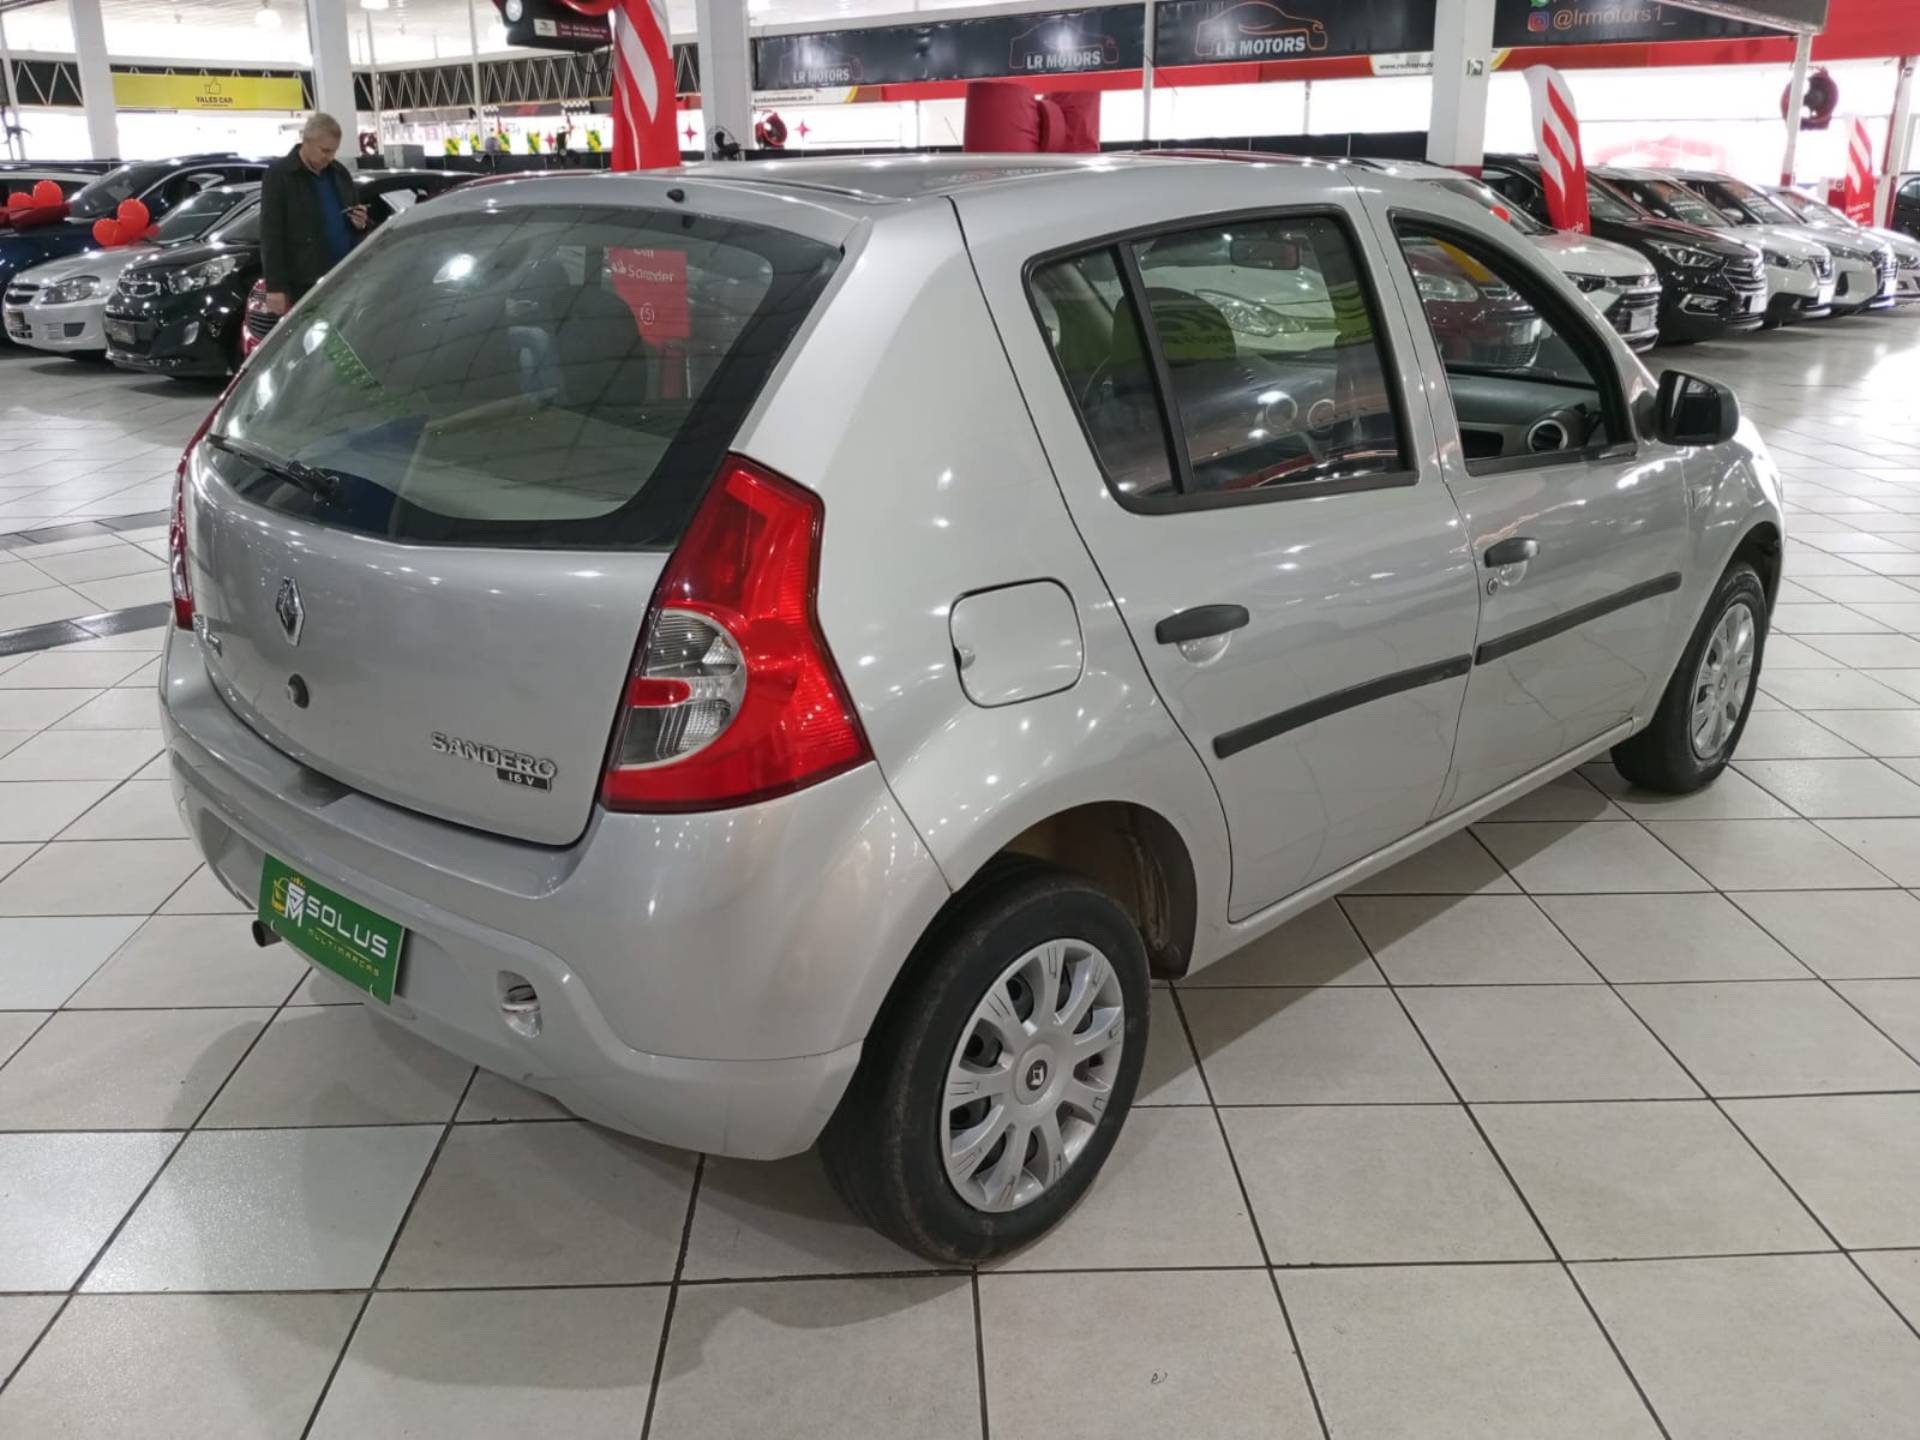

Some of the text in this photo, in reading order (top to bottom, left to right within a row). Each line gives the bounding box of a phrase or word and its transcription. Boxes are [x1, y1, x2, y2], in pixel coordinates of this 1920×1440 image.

[1553, 5, 1677, 31] @lrmotors1_
[1216, 36, 1306, 57] LR MOTORS
[1026, 50, 1101, 70] LR MOTORS
[792, 67, 850, 84] LR MOTORS
[431, 730, 558, 780] SANDERO
[306, 894, 389, 959] SOLUS
